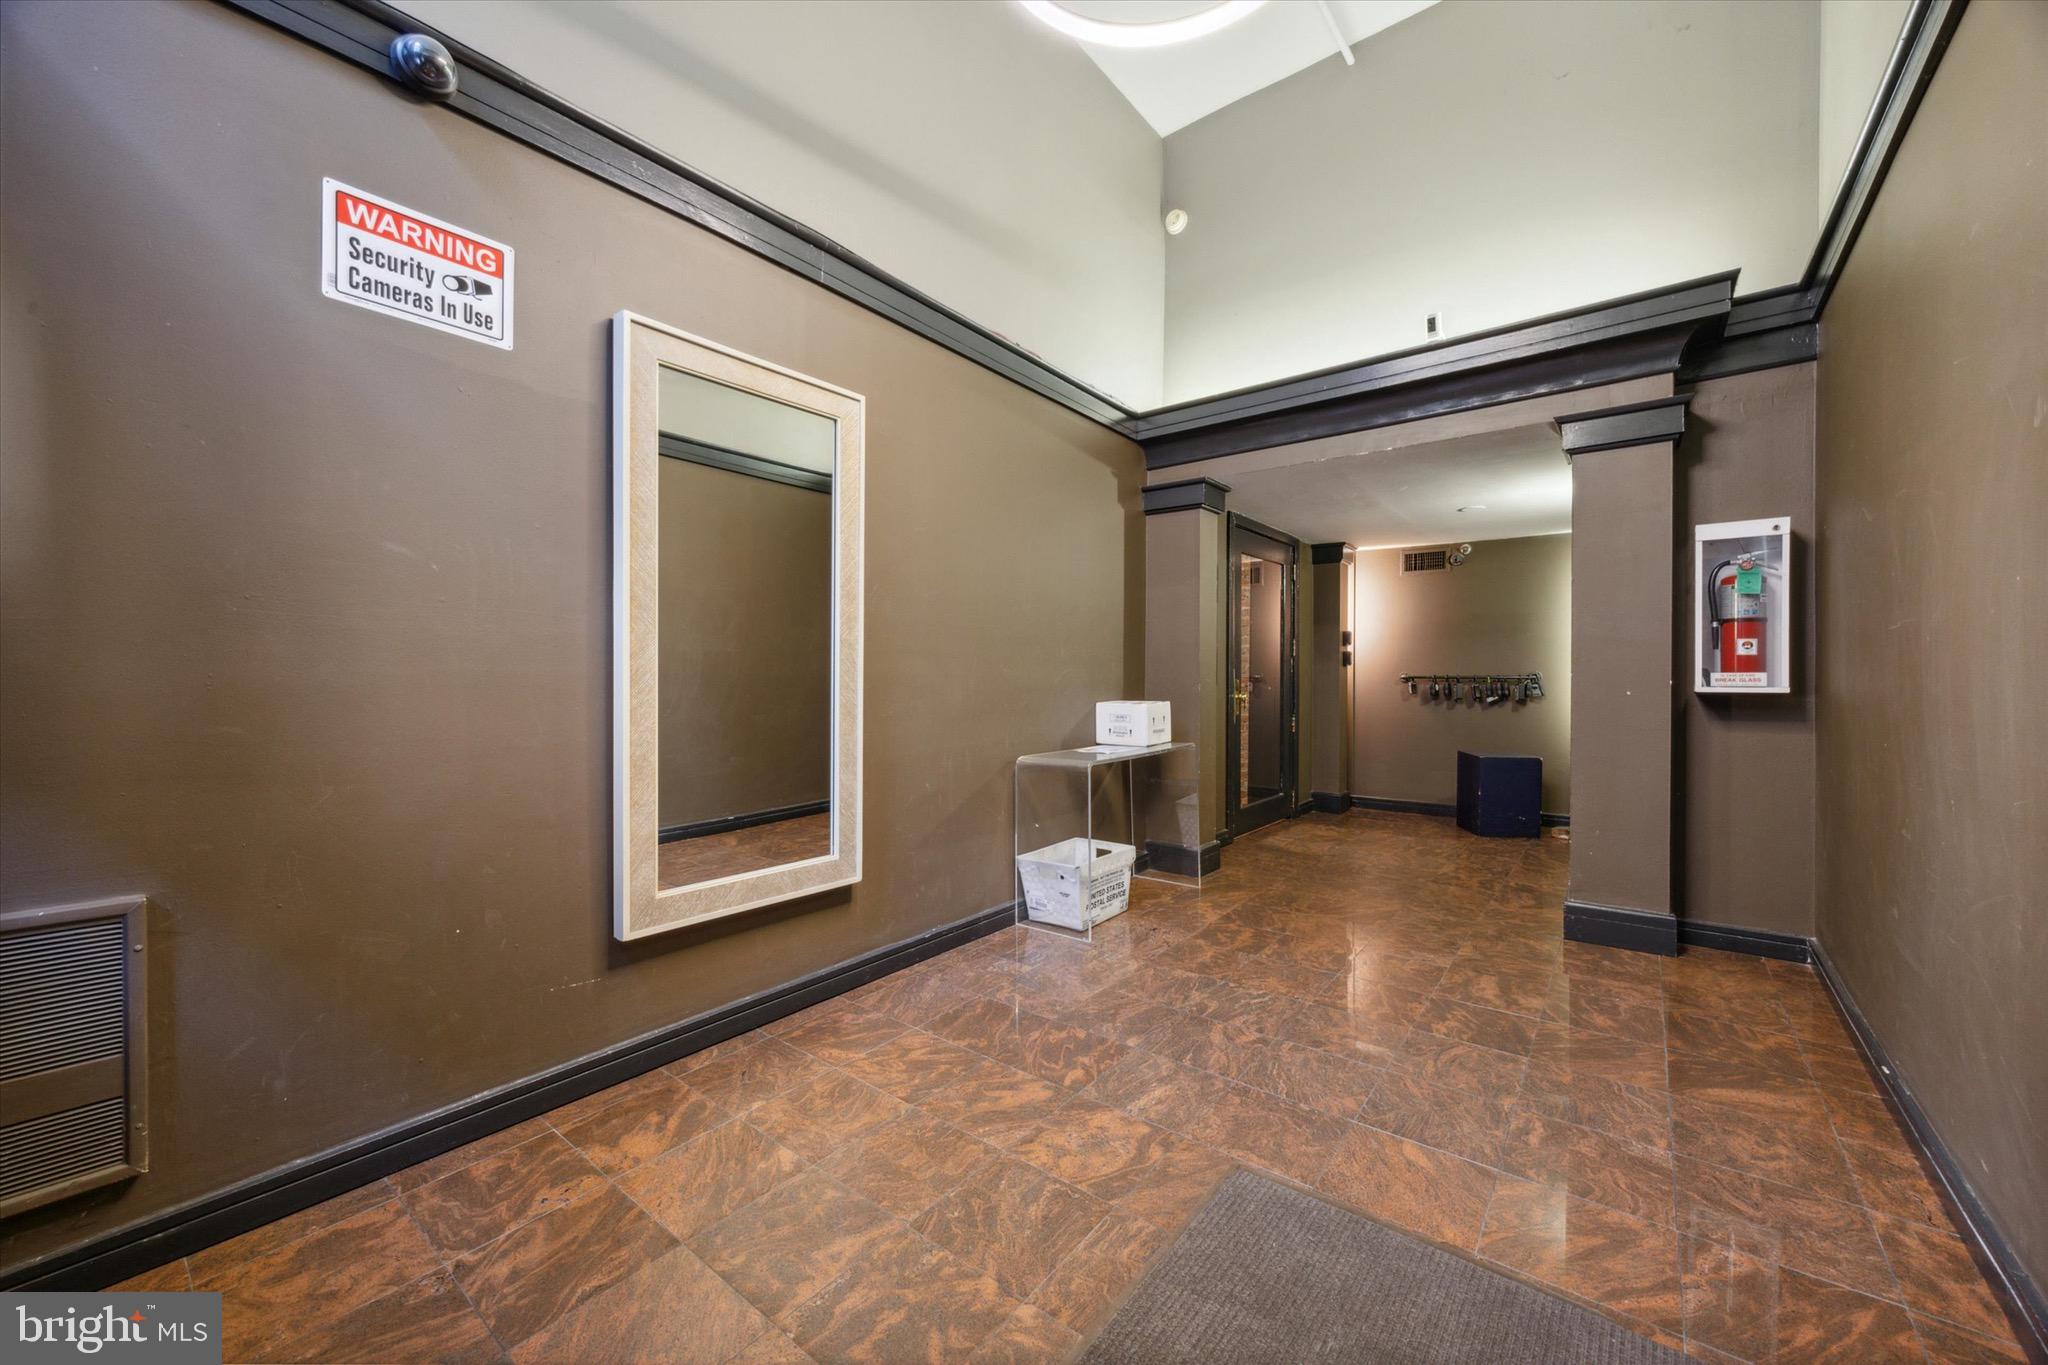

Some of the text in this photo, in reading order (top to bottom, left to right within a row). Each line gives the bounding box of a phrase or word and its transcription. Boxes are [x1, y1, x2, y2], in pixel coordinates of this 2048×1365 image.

[346, 199, 497, 273] WARNING
[348, 236, 435, 289] Security
[348, 266, 434, 313] Cameras
[441, 295, 457, 320] In
[463, 303, 494, 331] Use
[1106, 881, 1125, 894] STATES
[1106, 889, 1126, 903] SERVICE
